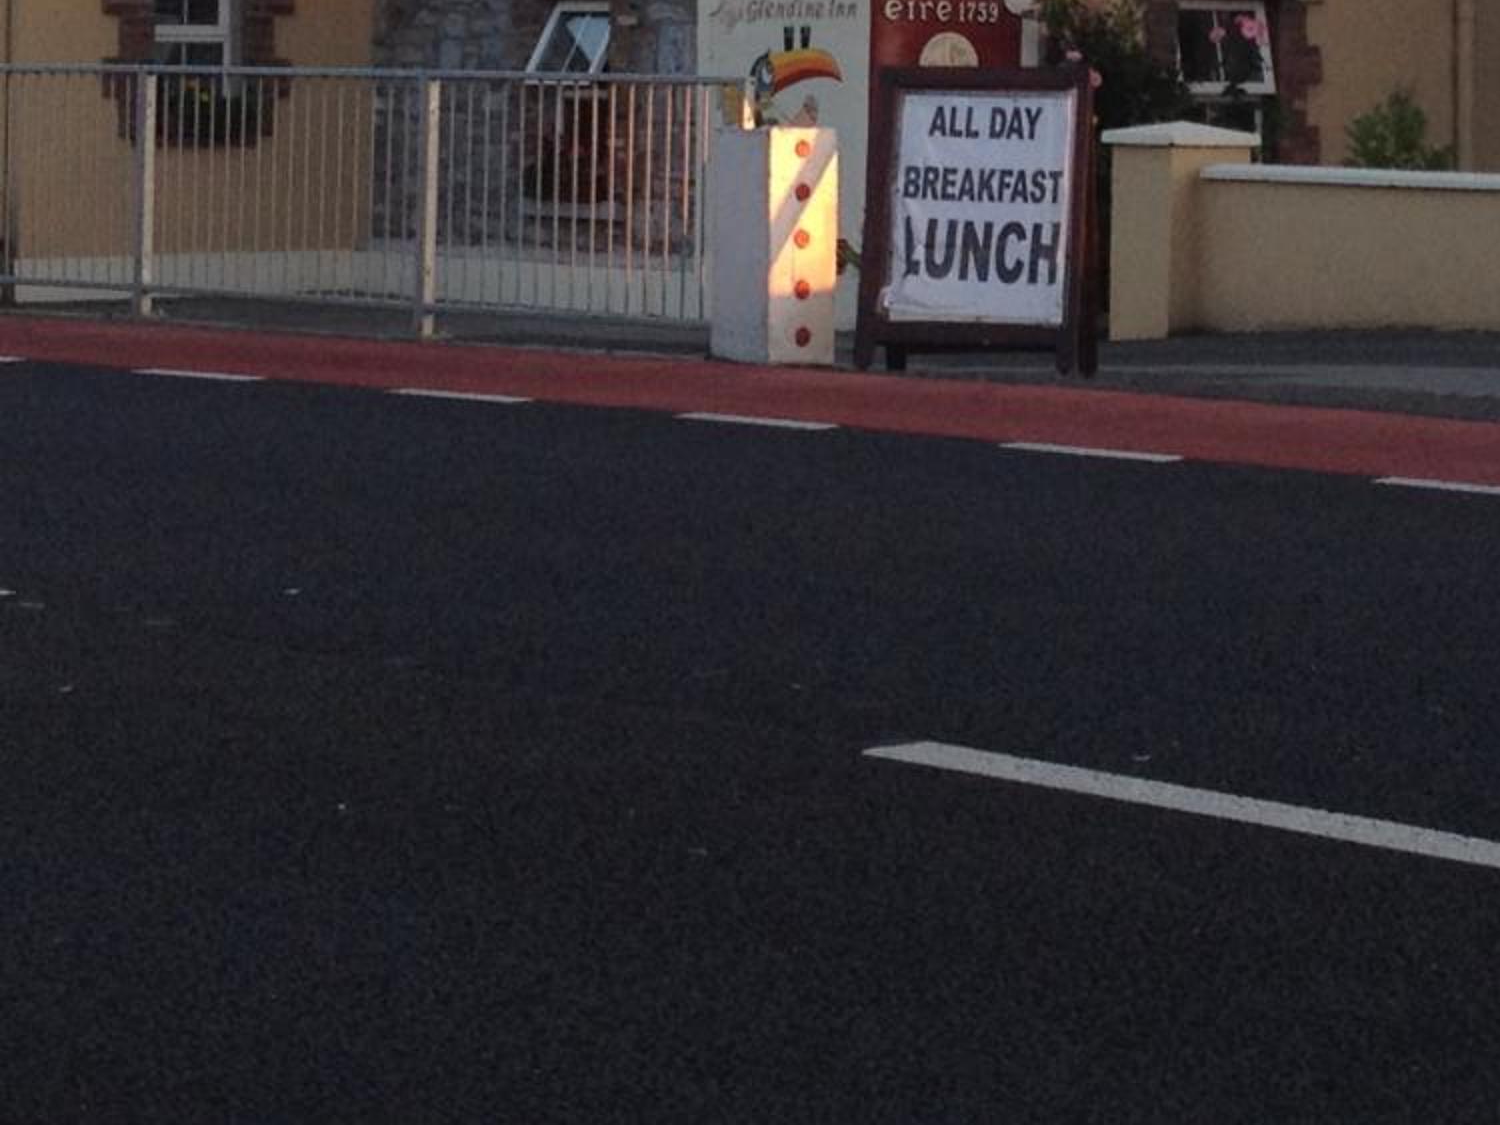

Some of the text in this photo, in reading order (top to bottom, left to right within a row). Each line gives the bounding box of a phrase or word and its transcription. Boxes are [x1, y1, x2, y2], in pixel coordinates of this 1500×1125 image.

[959, 0, 999, 24] 1759
[928, 106, 1043, 141] ALL DAY
[902, 165, 1063, 204] BREAKFAST
[902, 215, 1061, 286] LUNCH
